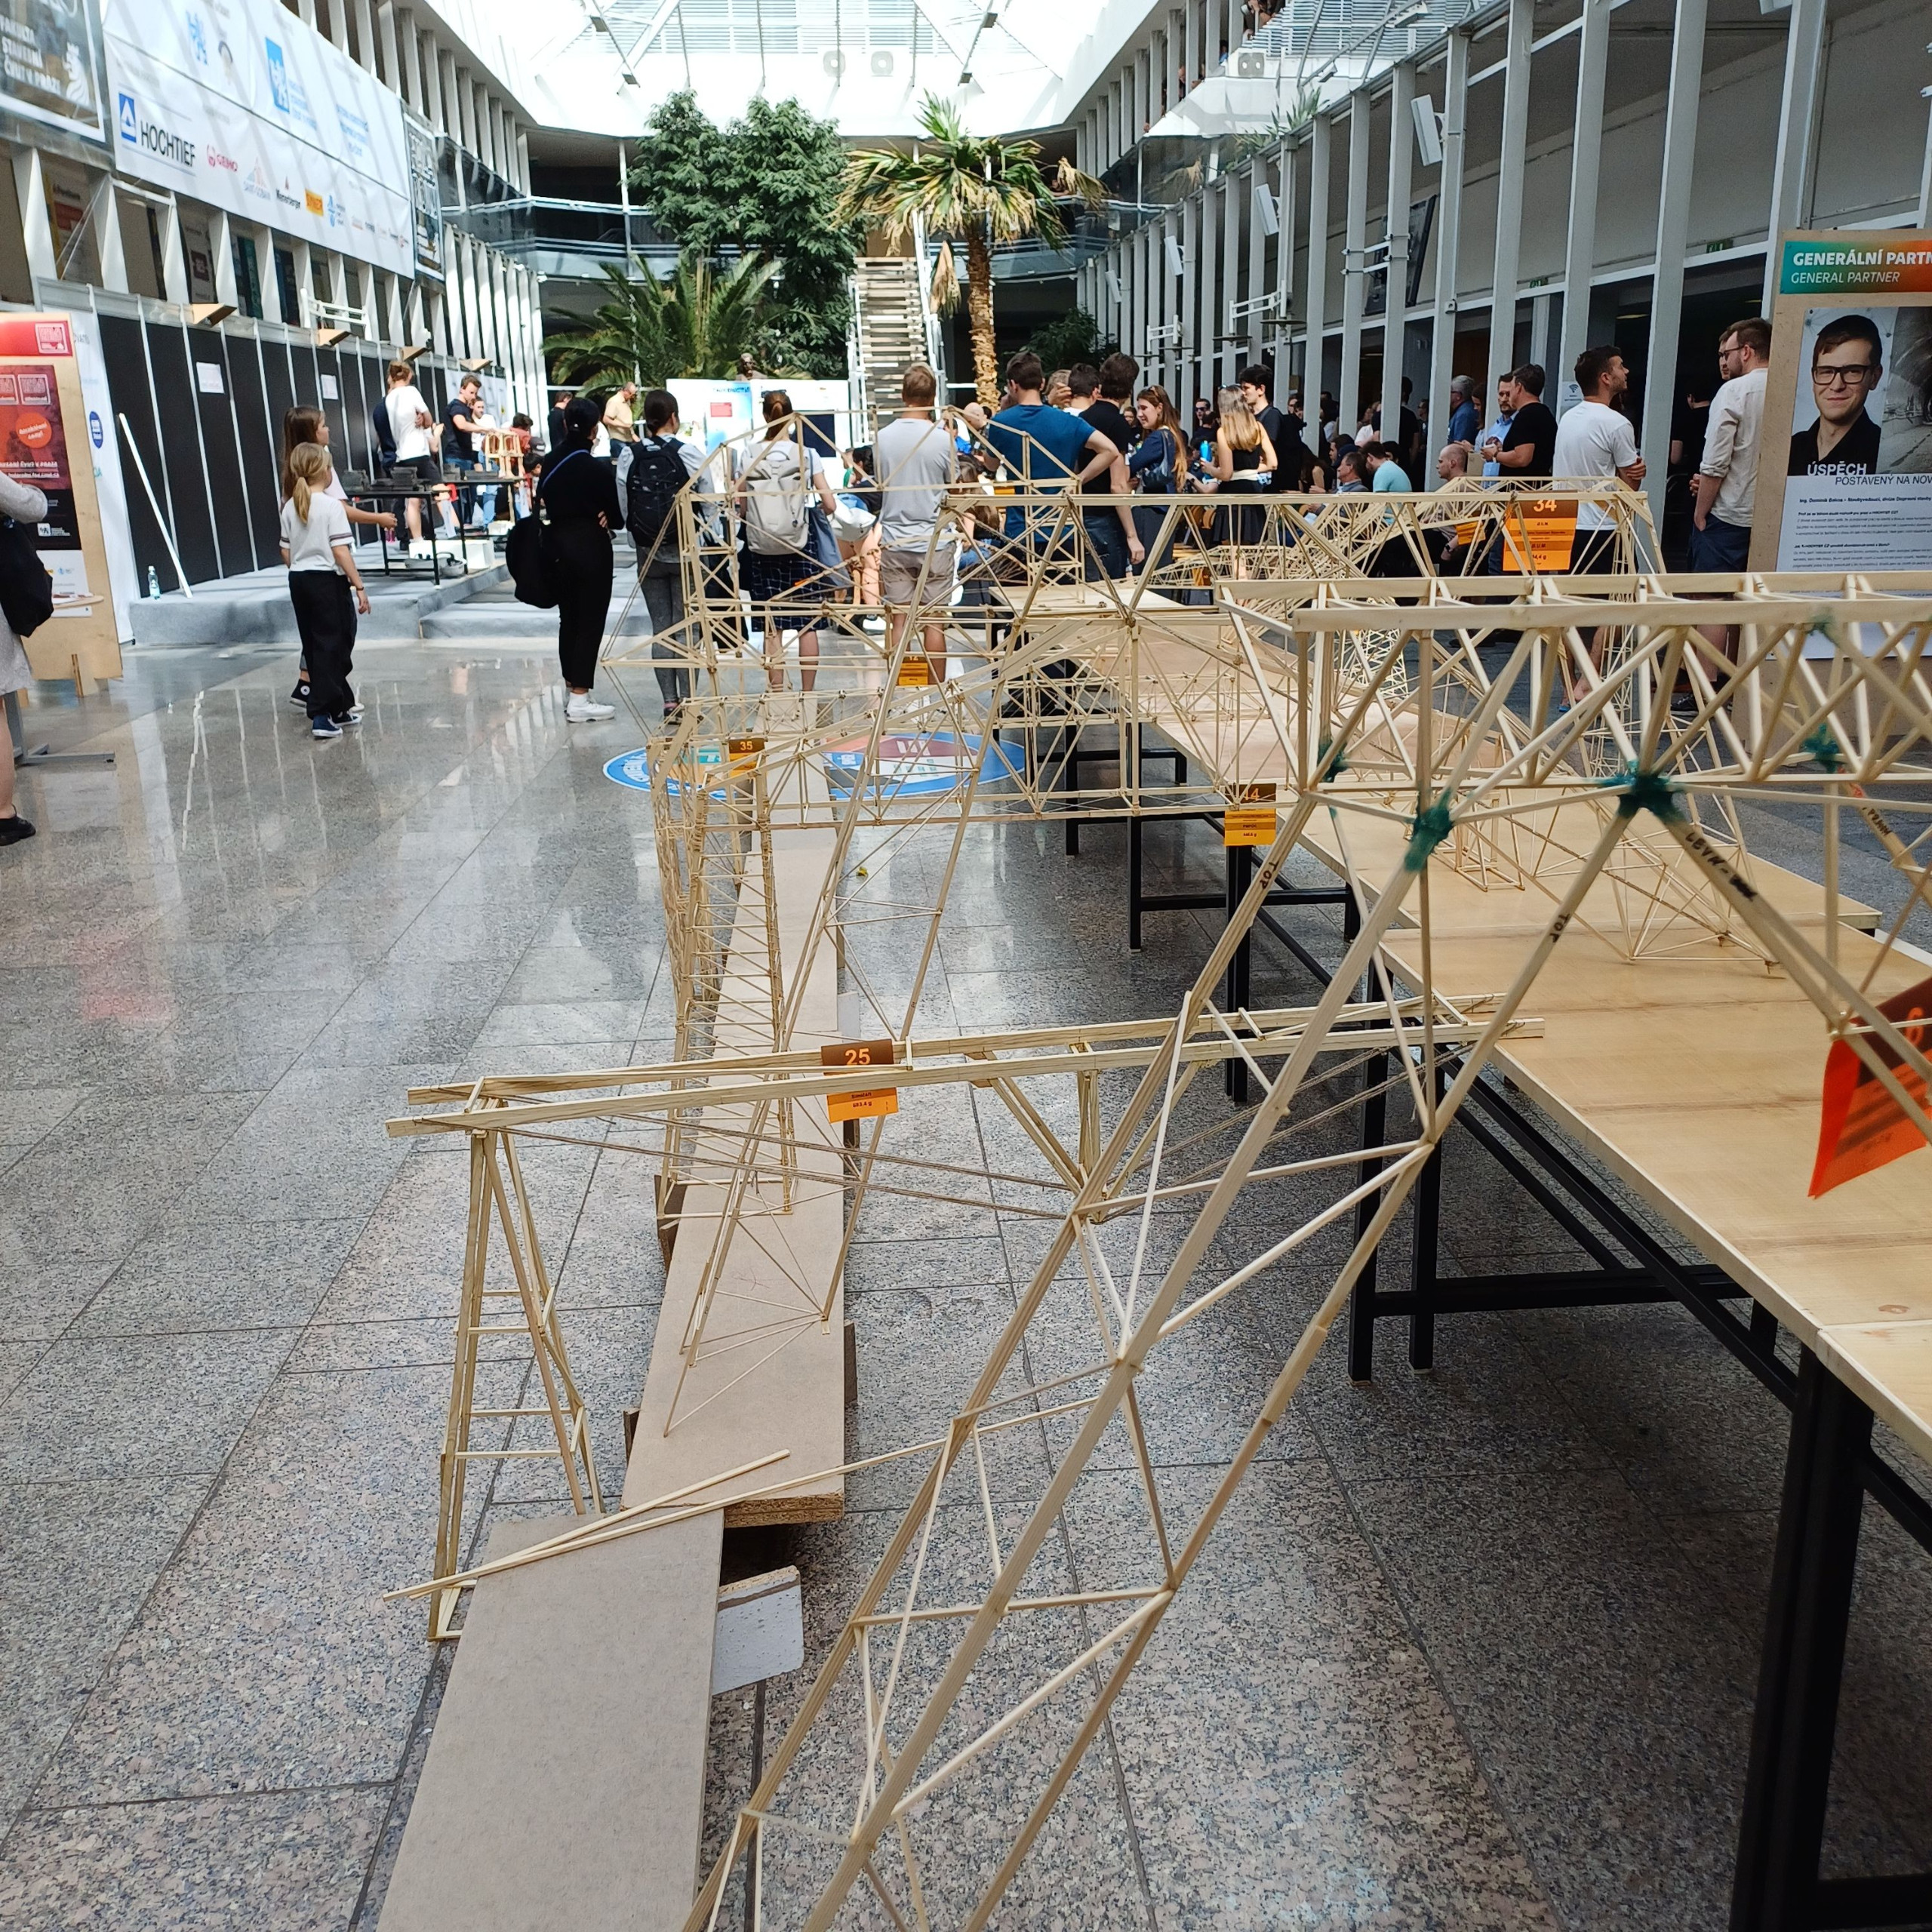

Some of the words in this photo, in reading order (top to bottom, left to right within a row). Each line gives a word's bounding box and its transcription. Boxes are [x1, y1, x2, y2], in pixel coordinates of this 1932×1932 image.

[140, 121, 196, 168] HOCHTIEF
[1792, 249, 1884, 266] GENERÁLNÍ
[1791, 272, 1844, 284] GENERAL
[1847, 271, 1900, 284] PARTNER
[1807, 461, 1867, 476] ÚSPĚCH
[1835, 473, 1894, 486] POSTAVENÝ
[1896, 475, 1910, 485] NA
[1533, 499, 1557, 512] 34
[740, 740, 753, 751] 35
[1259, 860, 1280, 889] TOP
[844, 1048, 871, 1066] 25
